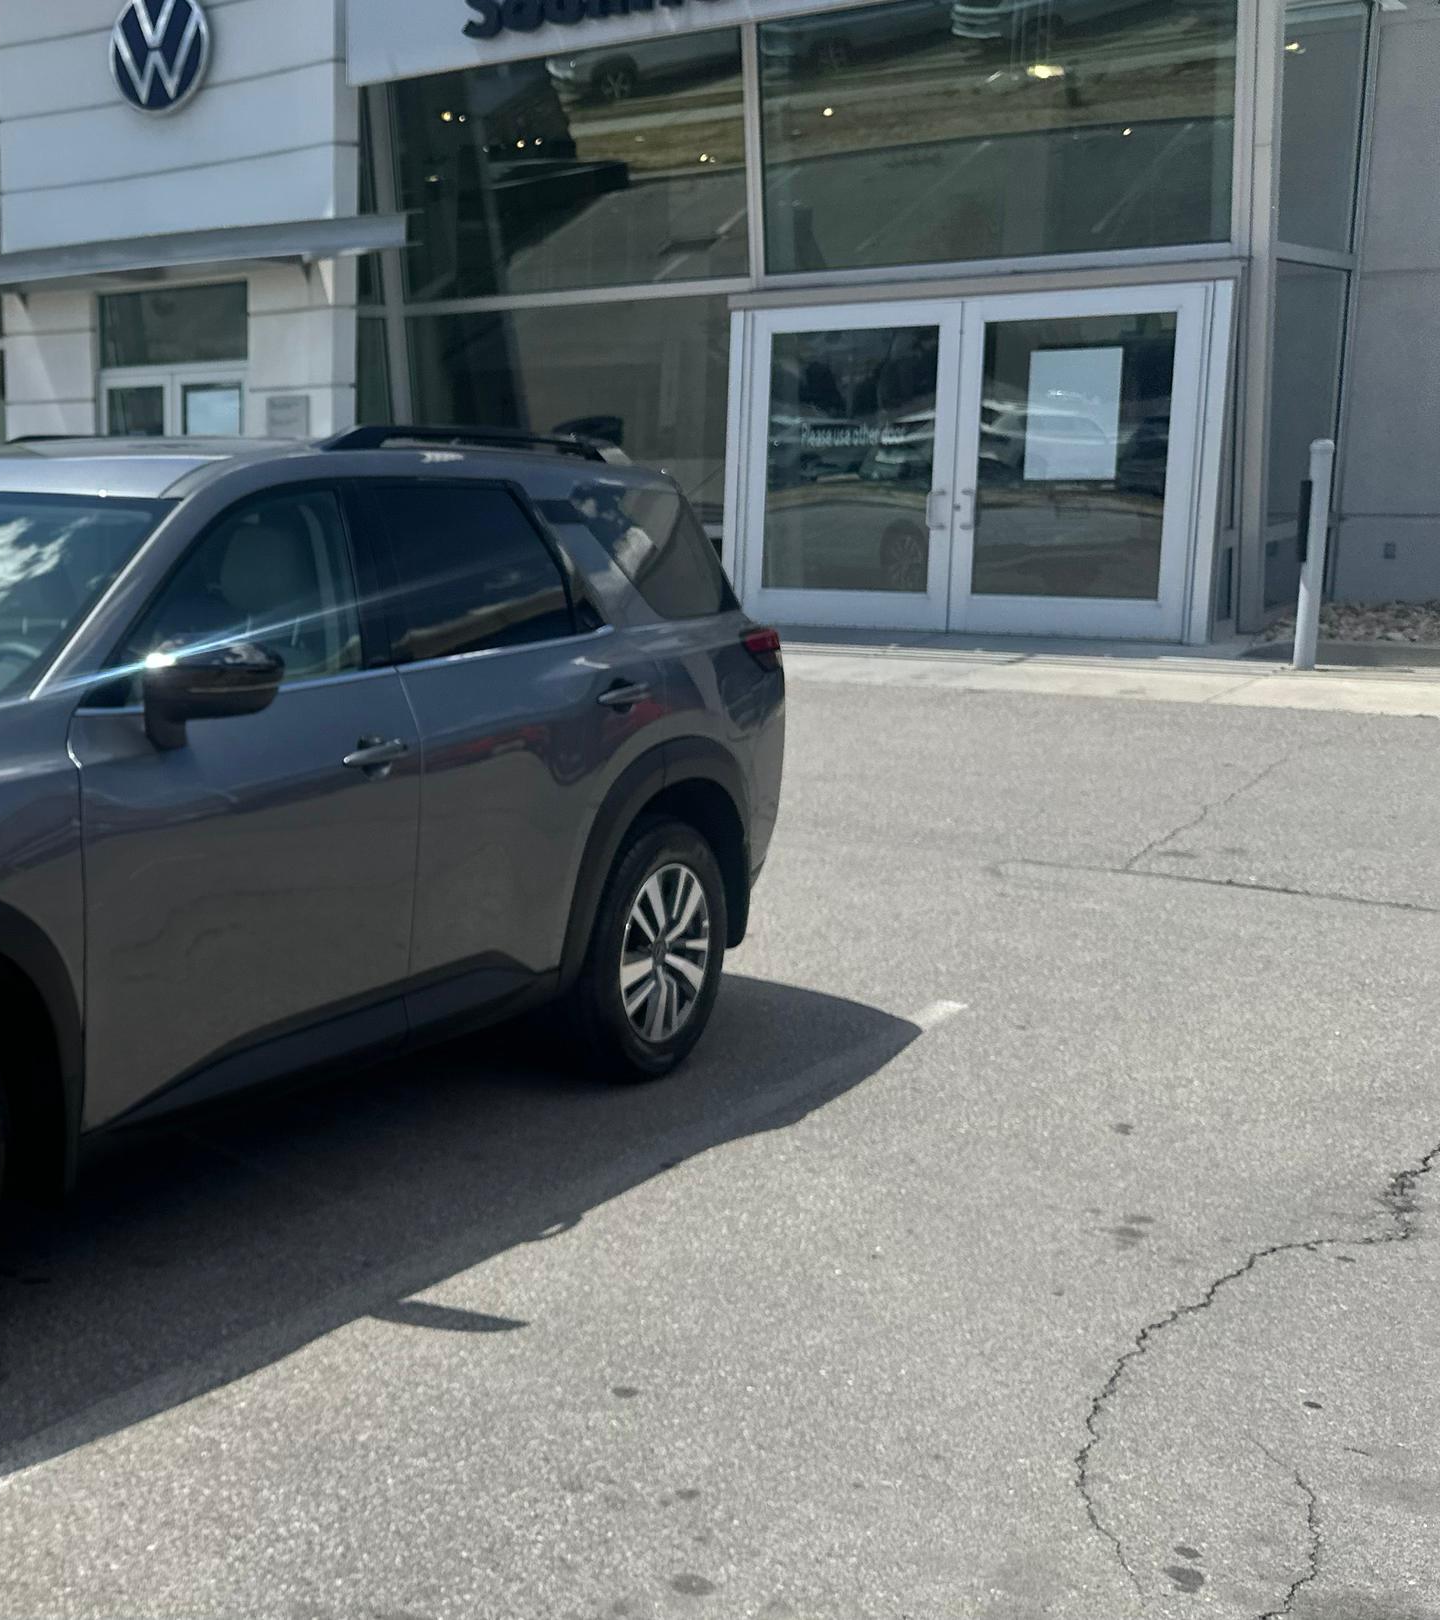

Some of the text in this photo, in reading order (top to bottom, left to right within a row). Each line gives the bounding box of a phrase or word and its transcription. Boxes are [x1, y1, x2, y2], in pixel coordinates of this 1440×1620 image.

[800, 422, 833, 447] Please
[833, 427, 851, 447] use
[852, 421, 880, 446] other
